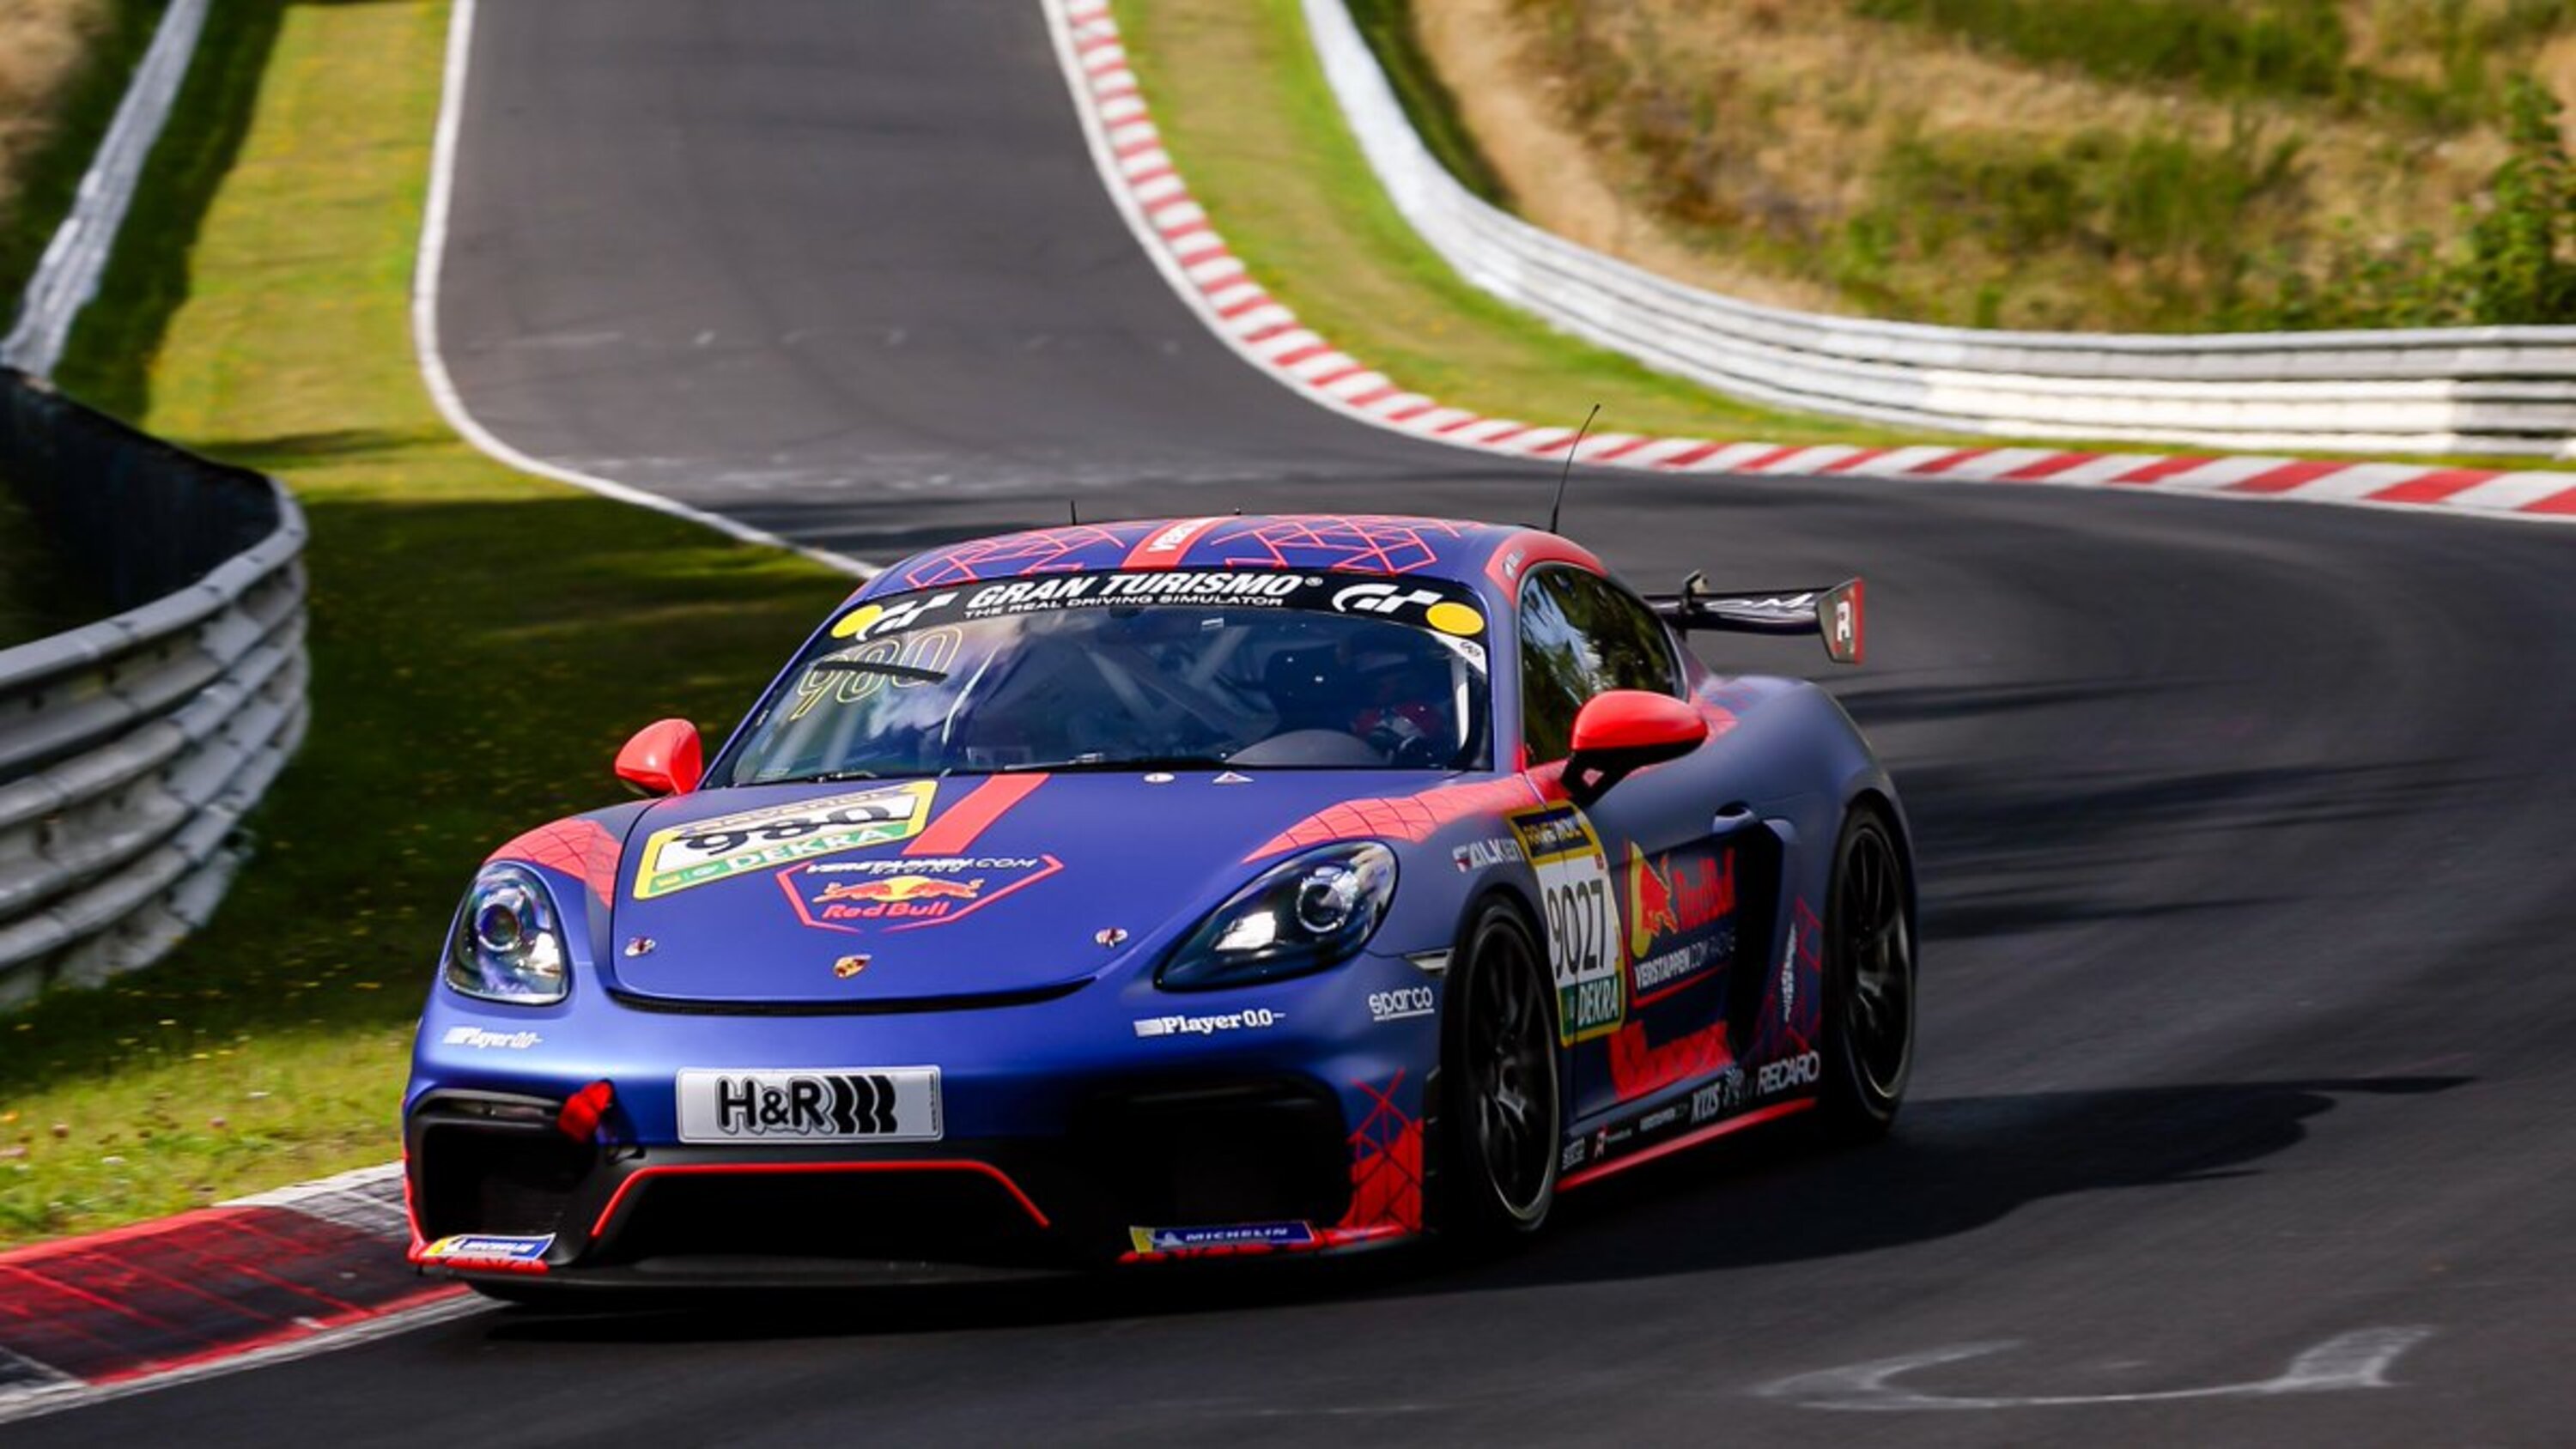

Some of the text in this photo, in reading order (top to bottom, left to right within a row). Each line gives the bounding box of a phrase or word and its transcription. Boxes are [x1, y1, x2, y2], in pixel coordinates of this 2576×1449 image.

[963, 594, 1284, 619] THE REAL DRIVING SIMULATOR
[966, 576, 1097, 609] GRAN
[789, 626, 963, 722] 980
[685, 805, 890, 856] 980
[728, 828, 895, 871] DEKRA
[822, 900, 951, 919] Red Bull
[1547, 878, 1605, 980] 9027
[1163, 1011, 1242, 1034] Player
[1369, 986, 1434, 1016] sparco
[1577, 976, 1619, 1027] DEKRA
[1757, 1051, 1820, 1095] RECARO
[718, 1076, 831, 1131] H&R
[1186, 1227, 1288, 1241] MICHELIN
